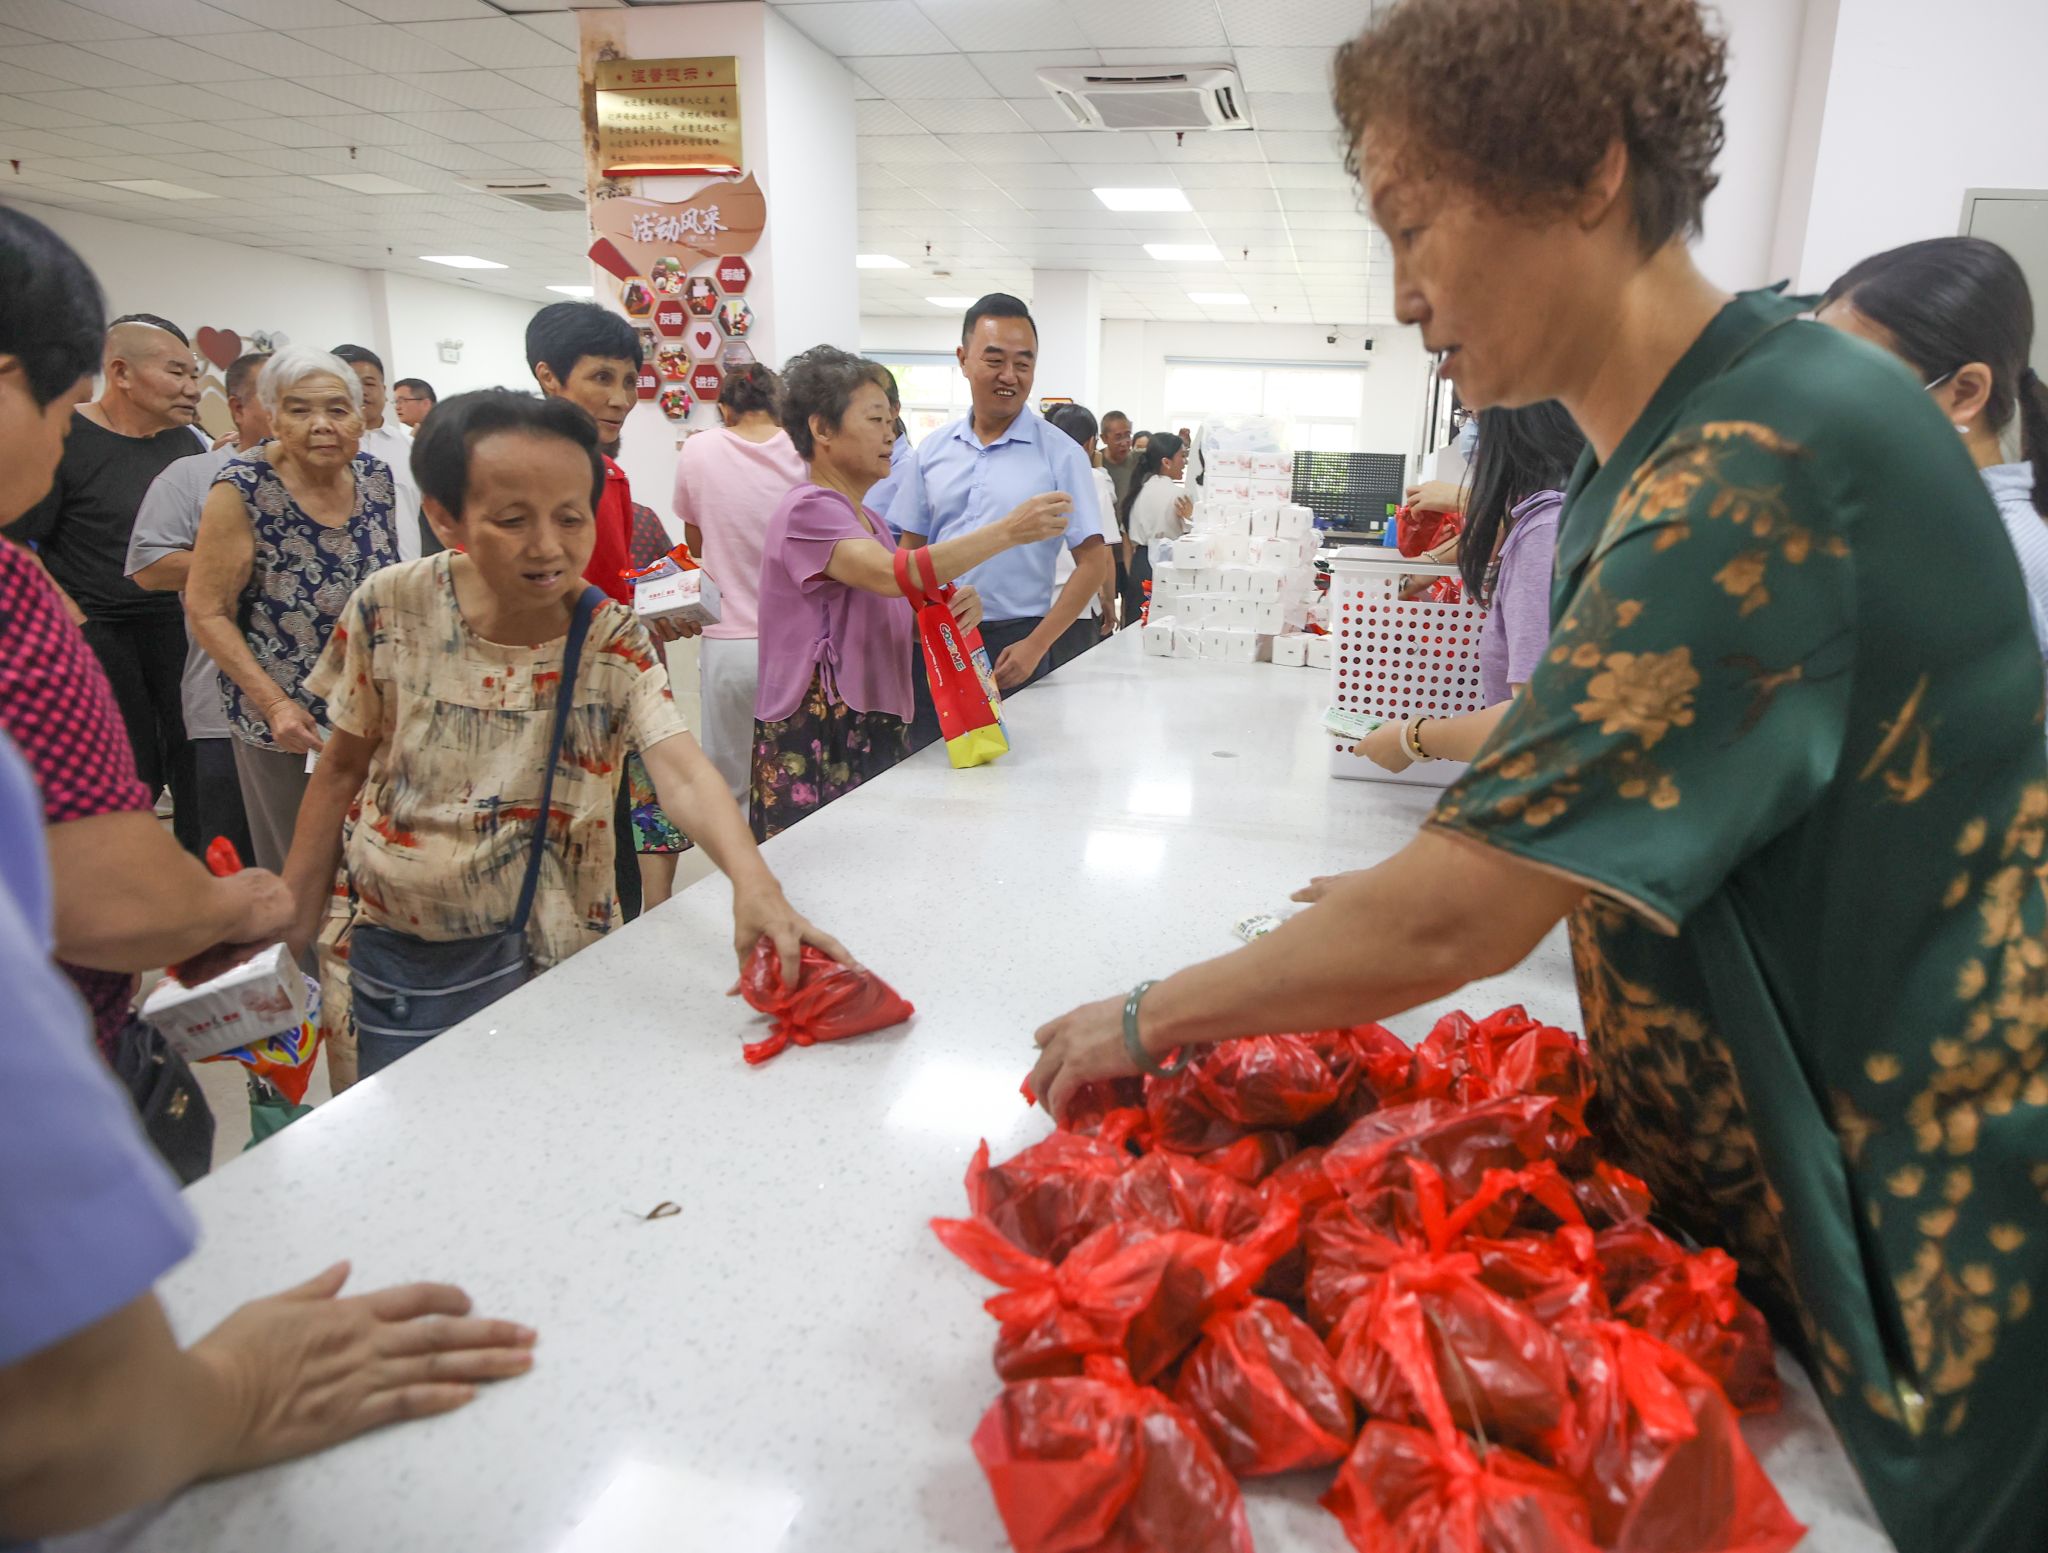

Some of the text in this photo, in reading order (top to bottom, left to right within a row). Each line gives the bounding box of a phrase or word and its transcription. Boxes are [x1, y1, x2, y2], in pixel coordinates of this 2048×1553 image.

[632, 205, 728, 243] 活动风采
[658, 312, 683, 325] 友爱
[694, 375, 719, 389] 进步
